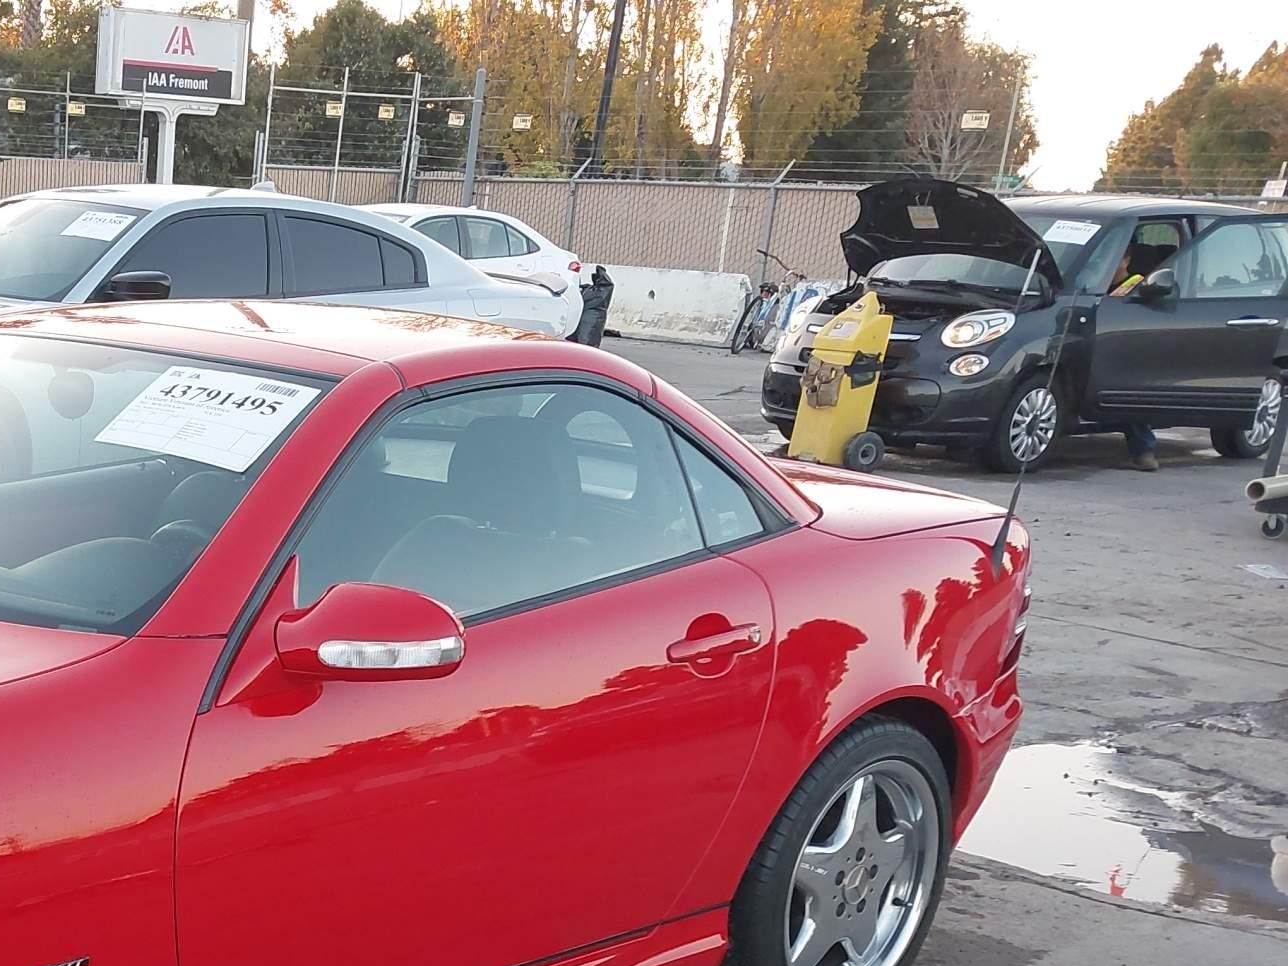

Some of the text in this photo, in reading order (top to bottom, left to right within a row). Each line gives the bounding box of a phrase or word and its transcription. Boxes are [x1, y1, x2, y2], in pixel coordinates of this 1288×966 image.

[148, 72, 209, 90] IAA Fremont
[159, 383, 284, 416] 43791495
